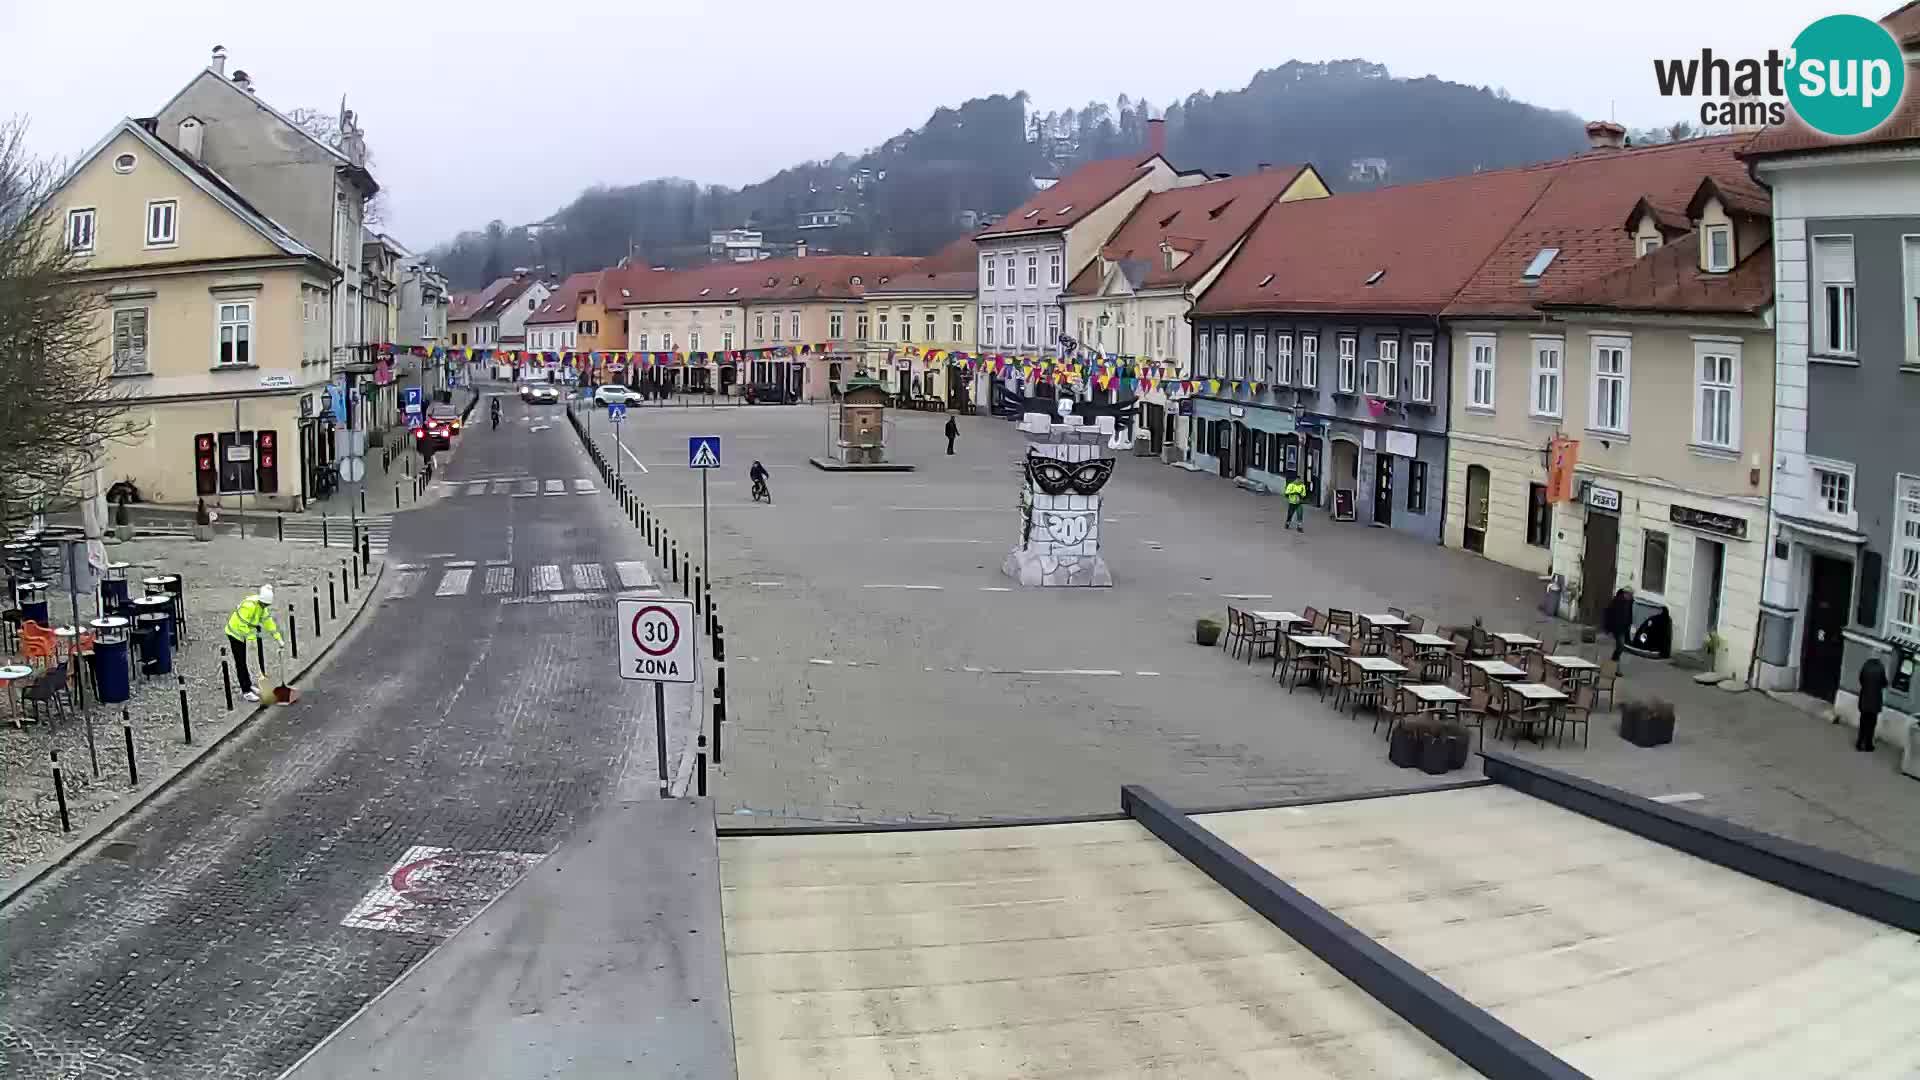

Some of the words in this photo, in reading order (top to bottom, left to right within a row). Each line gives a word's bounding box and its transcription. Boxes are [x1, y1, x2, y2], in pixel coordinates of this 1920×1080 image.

[409, 391, 416, 402] P
[644, 622, 668, 643] 30
[634, 659, 679, 675] ZONA
